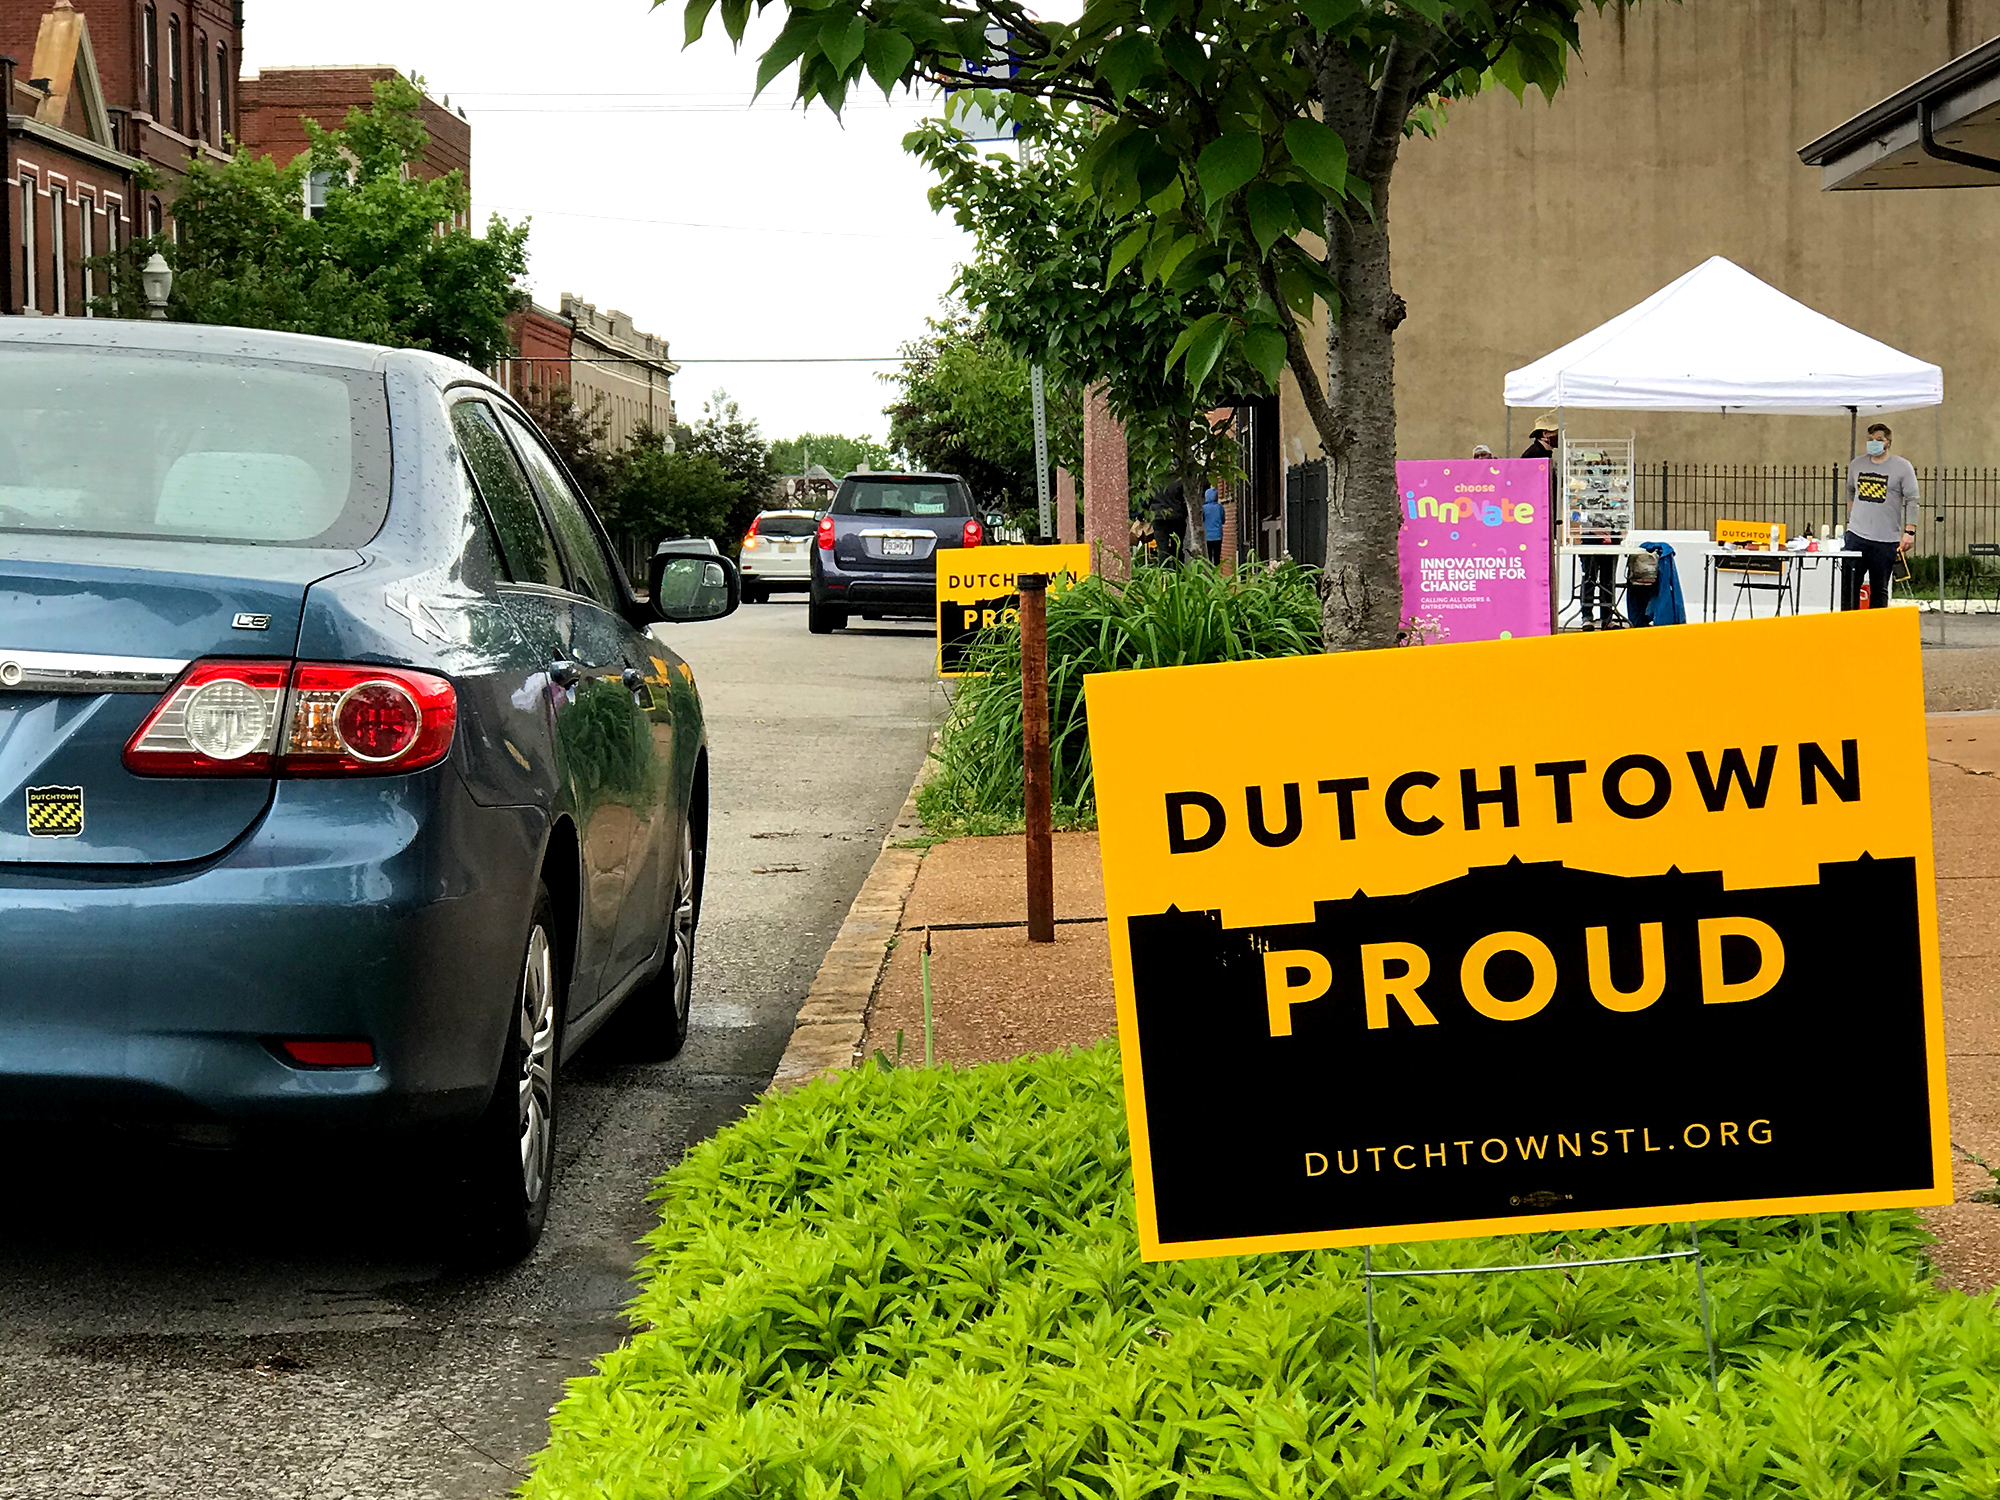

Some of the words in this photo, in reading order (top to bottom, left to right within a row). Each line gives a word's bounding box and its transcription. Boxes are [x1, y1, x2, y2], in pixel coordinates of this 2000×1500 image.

[1454, 483, 1496, 493] choose
[1406, 491, 1534, 526] innovate
[1722, 530, 1781, 539] DUTCHTOW
[1420, 557, 1506, 569] INNOVATION
[1509, 557, 1522, 568] IS
[1420, 569, 1445, 580] THE
[1447, 569, 1497, 580] ENGINE
[1499, 568, 1527, 580] FOR
[1420, 580, 1477, 592] CHANGE
[1165, 739, 1861, 854] DUTCHTOWN
[1264, 915, 1786, 1037] PROUD
[1305, 1118, 1773, 1177] DUTCHTOWNSTL.ORG
